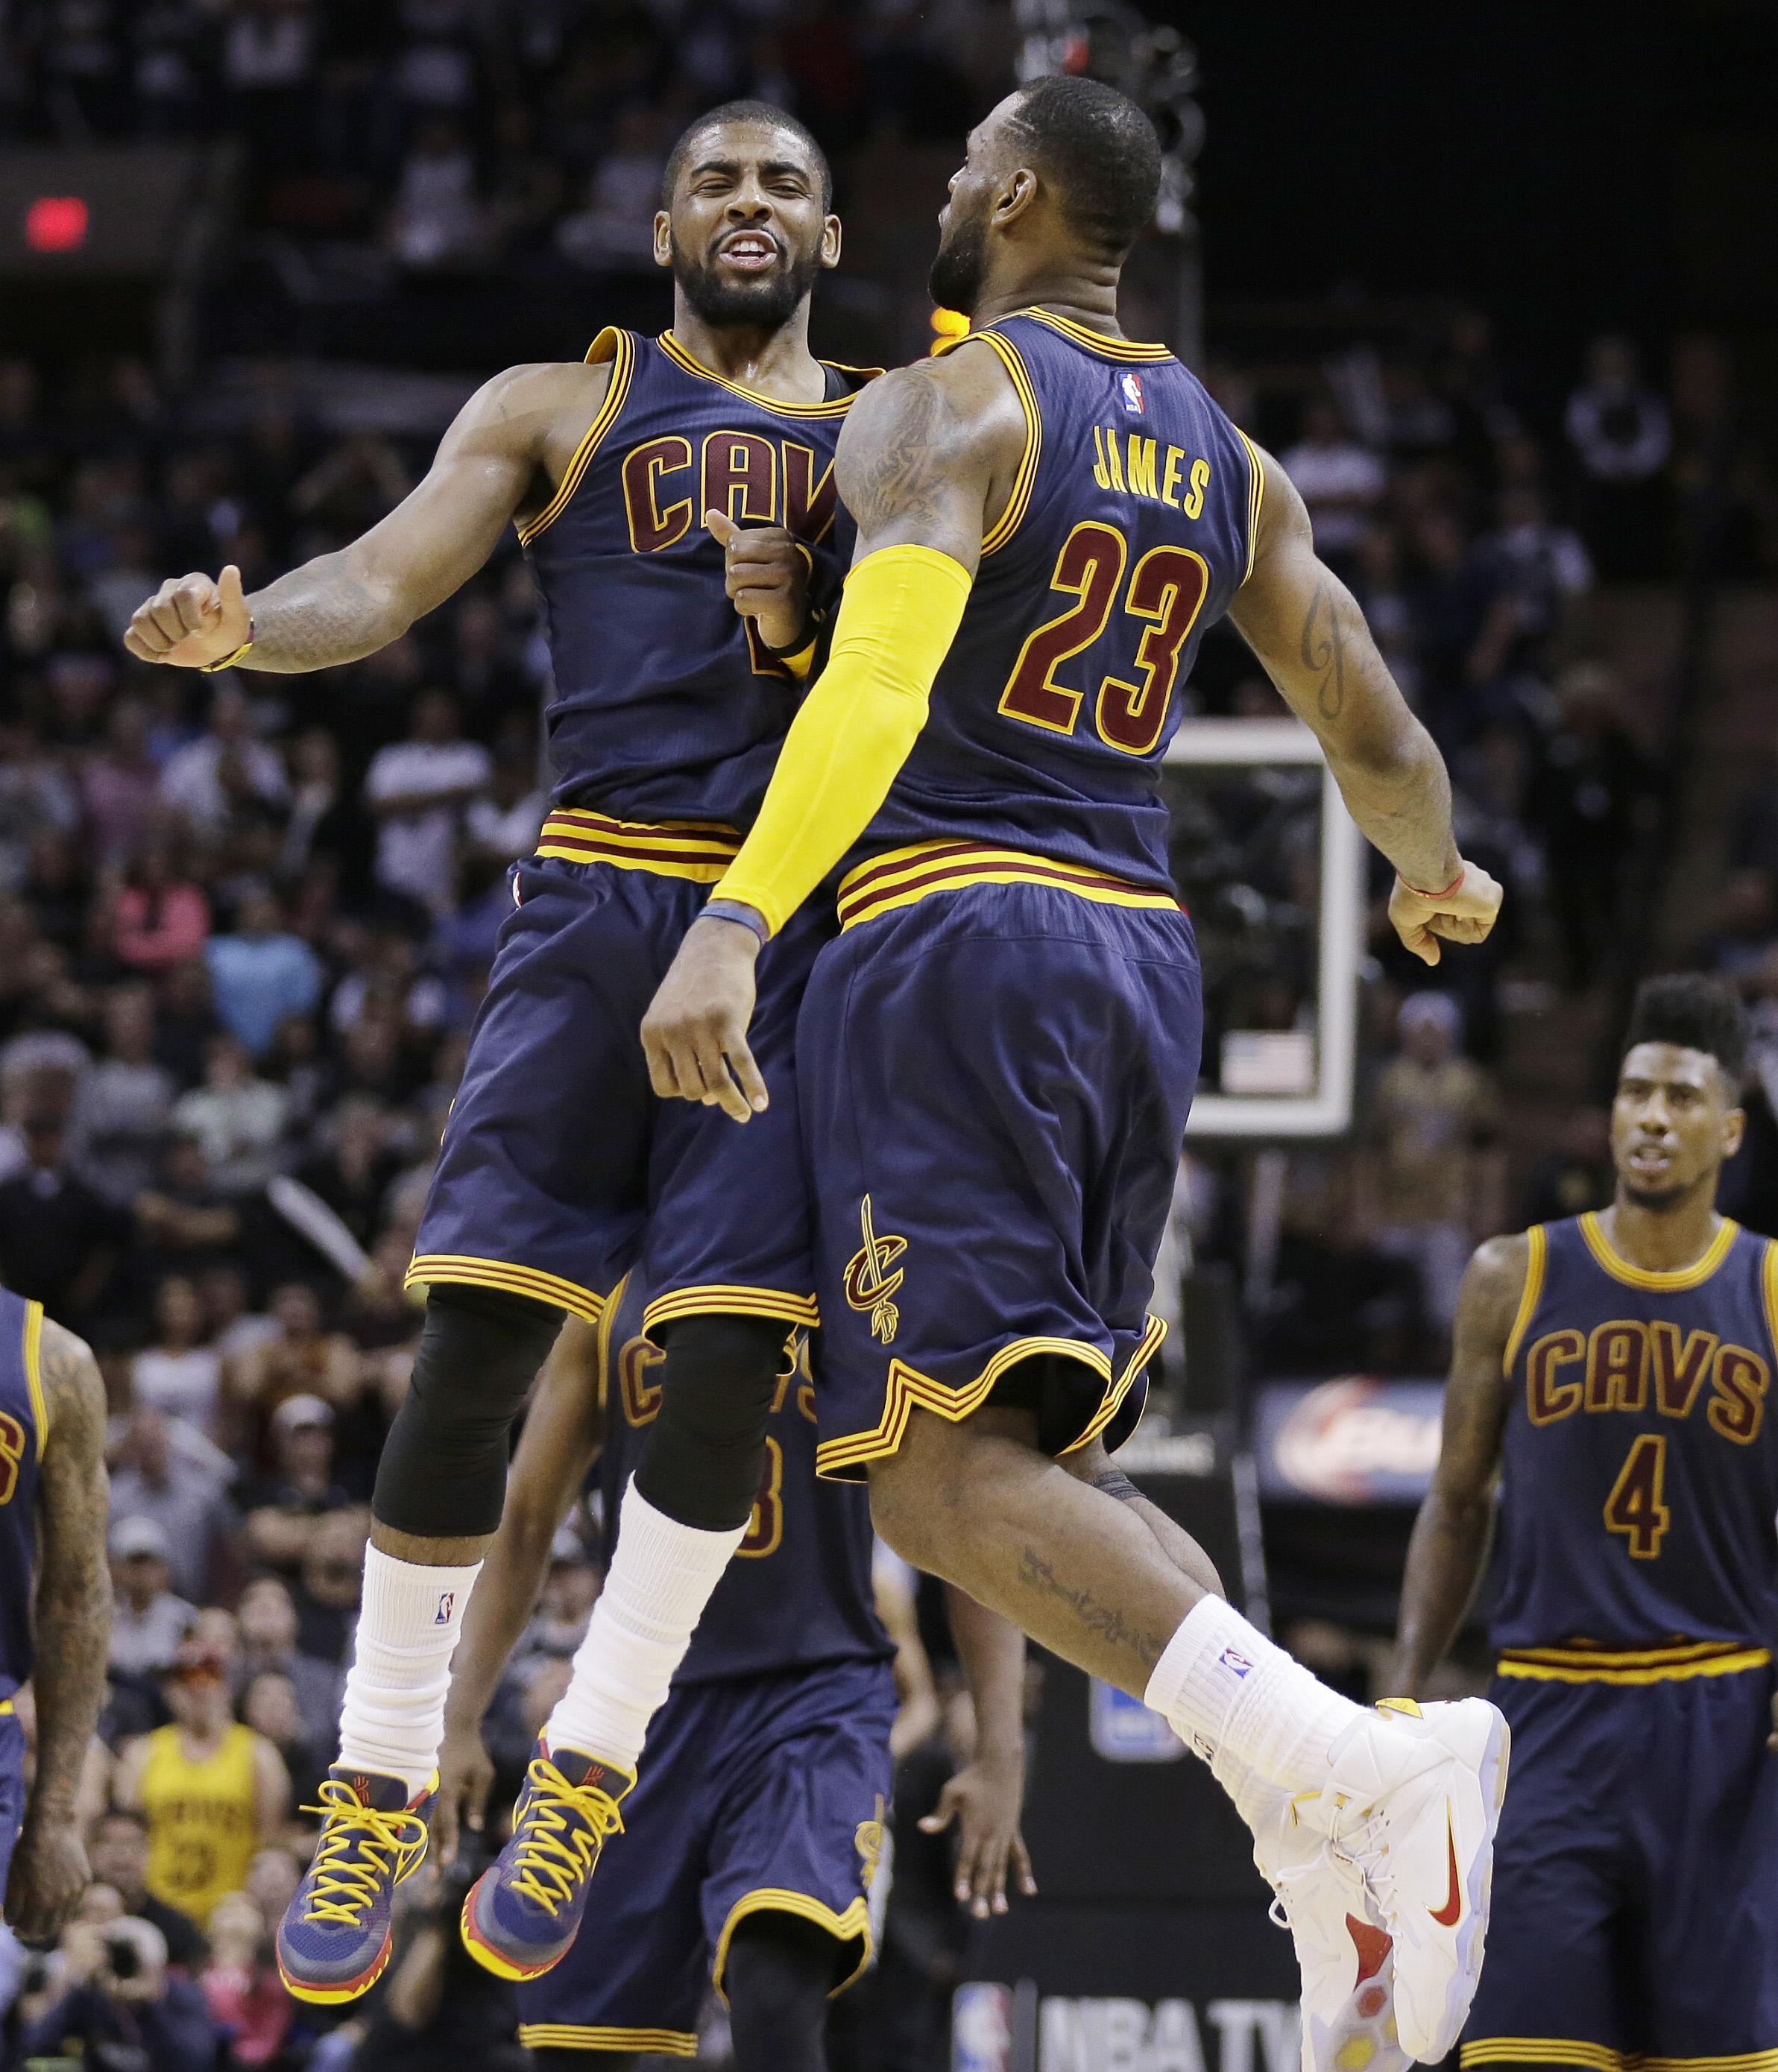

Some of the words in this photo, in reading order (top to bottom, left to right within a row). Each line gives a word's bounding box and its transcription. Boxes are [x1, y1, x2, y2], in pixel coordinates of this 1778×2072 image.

[621, 429, 836, 554] CAV
[1093, 425, 1211, 520] JAMES
[997, 519, 1209, 756] 23
[1527, 1319, 1771, 1445] CAVS
[1603, 1433, 1670, 1559] 4
[1039, 1995, 1207, 2072] NBA
